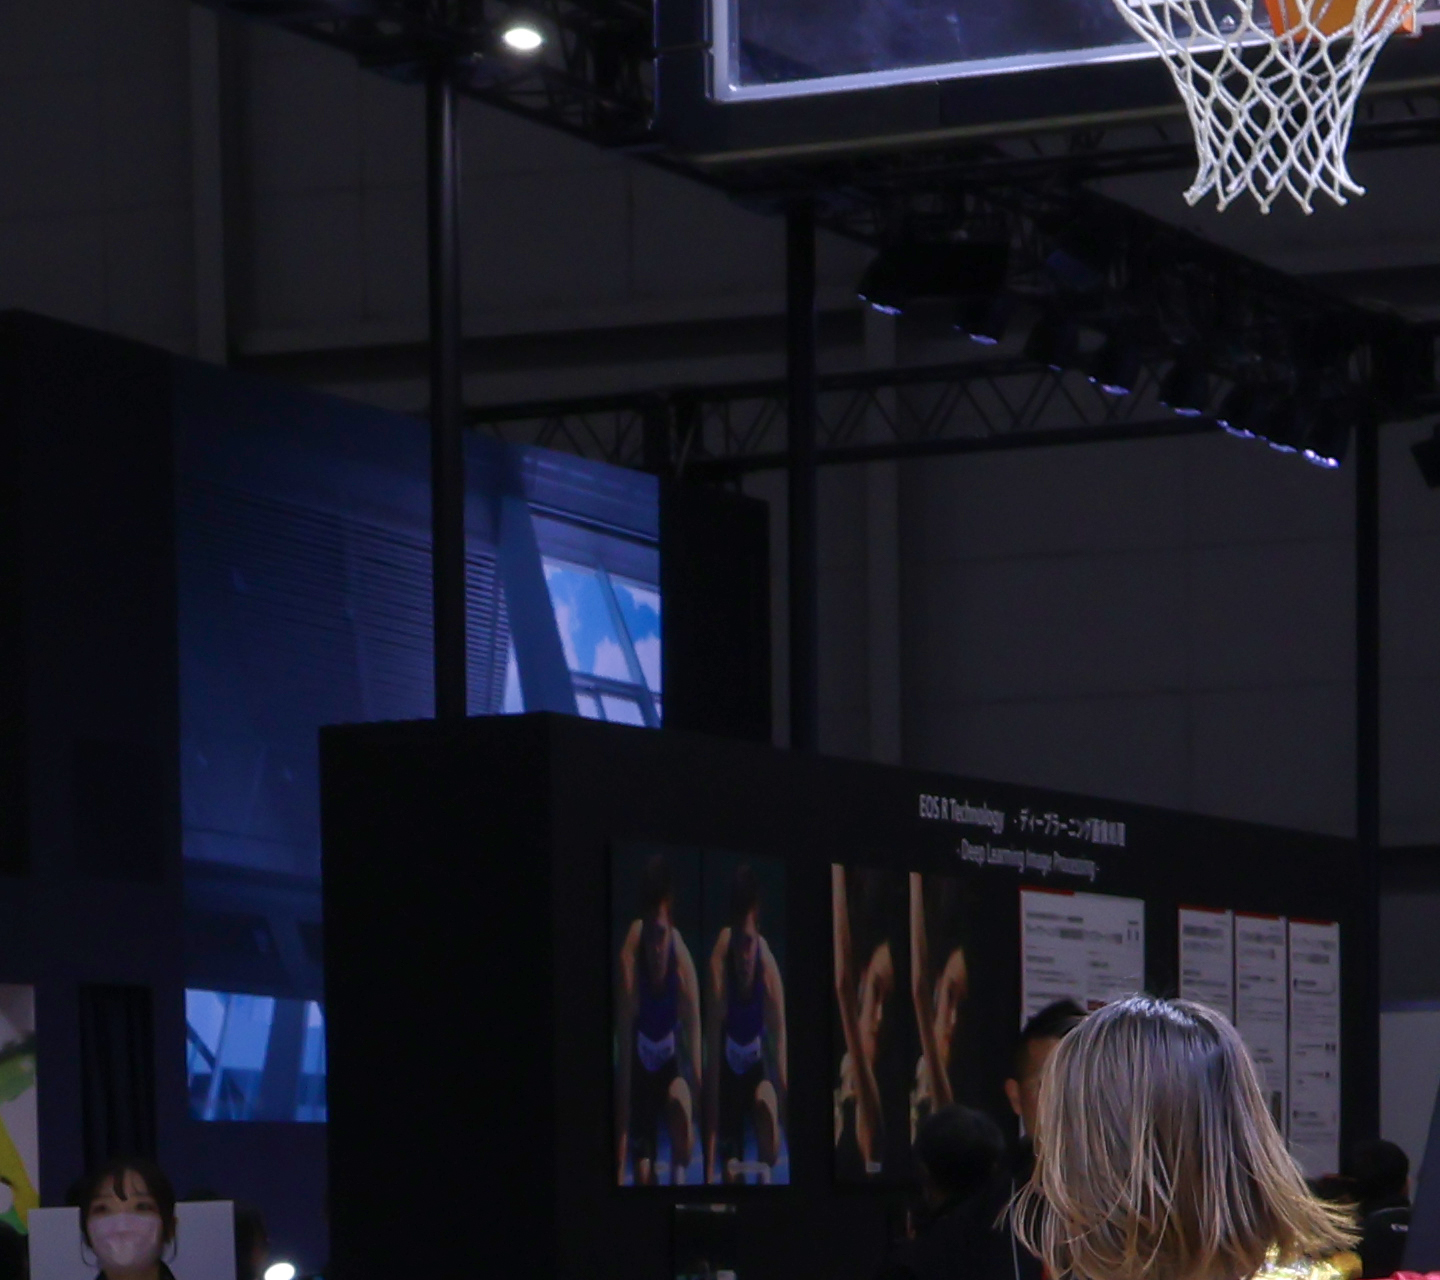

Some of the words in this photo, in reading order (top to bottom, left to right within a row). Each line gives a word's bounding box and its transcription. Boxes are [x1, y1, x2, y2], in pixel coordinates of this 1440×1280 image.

[919, 793, 939, 819] EOS
[941, 796, 948, 820] R
[949, 798, 1005, 834] Technology
